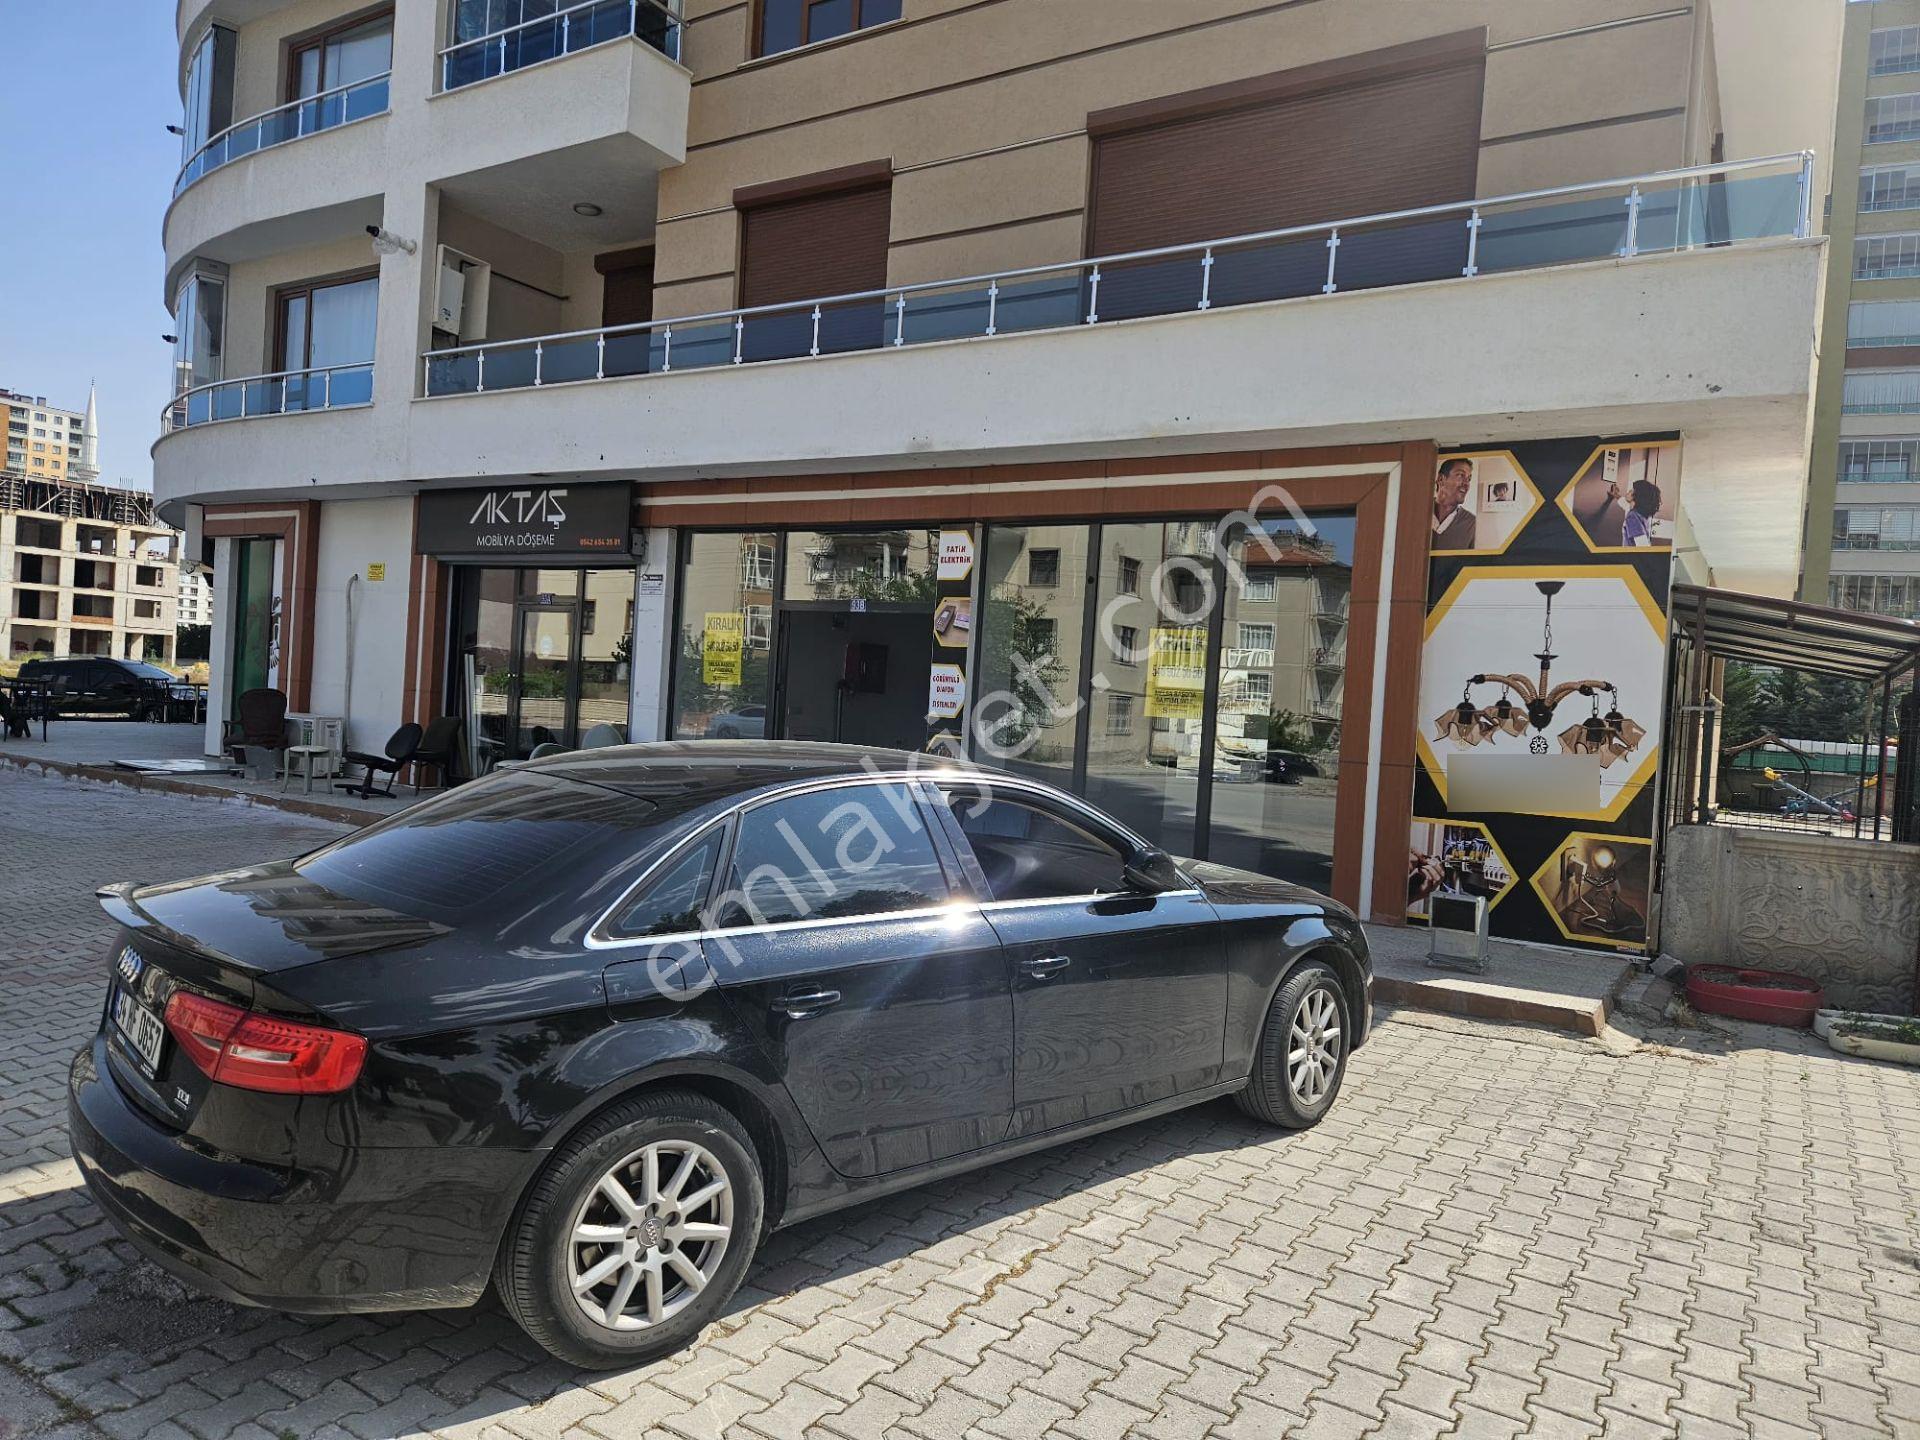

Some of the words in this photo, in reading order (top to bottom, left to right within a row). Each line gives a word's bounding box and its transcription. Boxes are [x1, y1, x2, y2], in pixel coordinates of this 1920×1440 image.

[469, 488, 568, 530] AKTAŞ
[476, 533, 516, 547] MOBİLYA
[517, 532, 555, 548] DÖŞEME
[946, 545, 966, 553] FATİH
[940, 556, 971, 564] ELEKTRİK
[707, 616, 742, 631] KİRALIK
[138, 1010, 162, 1061] 0657
